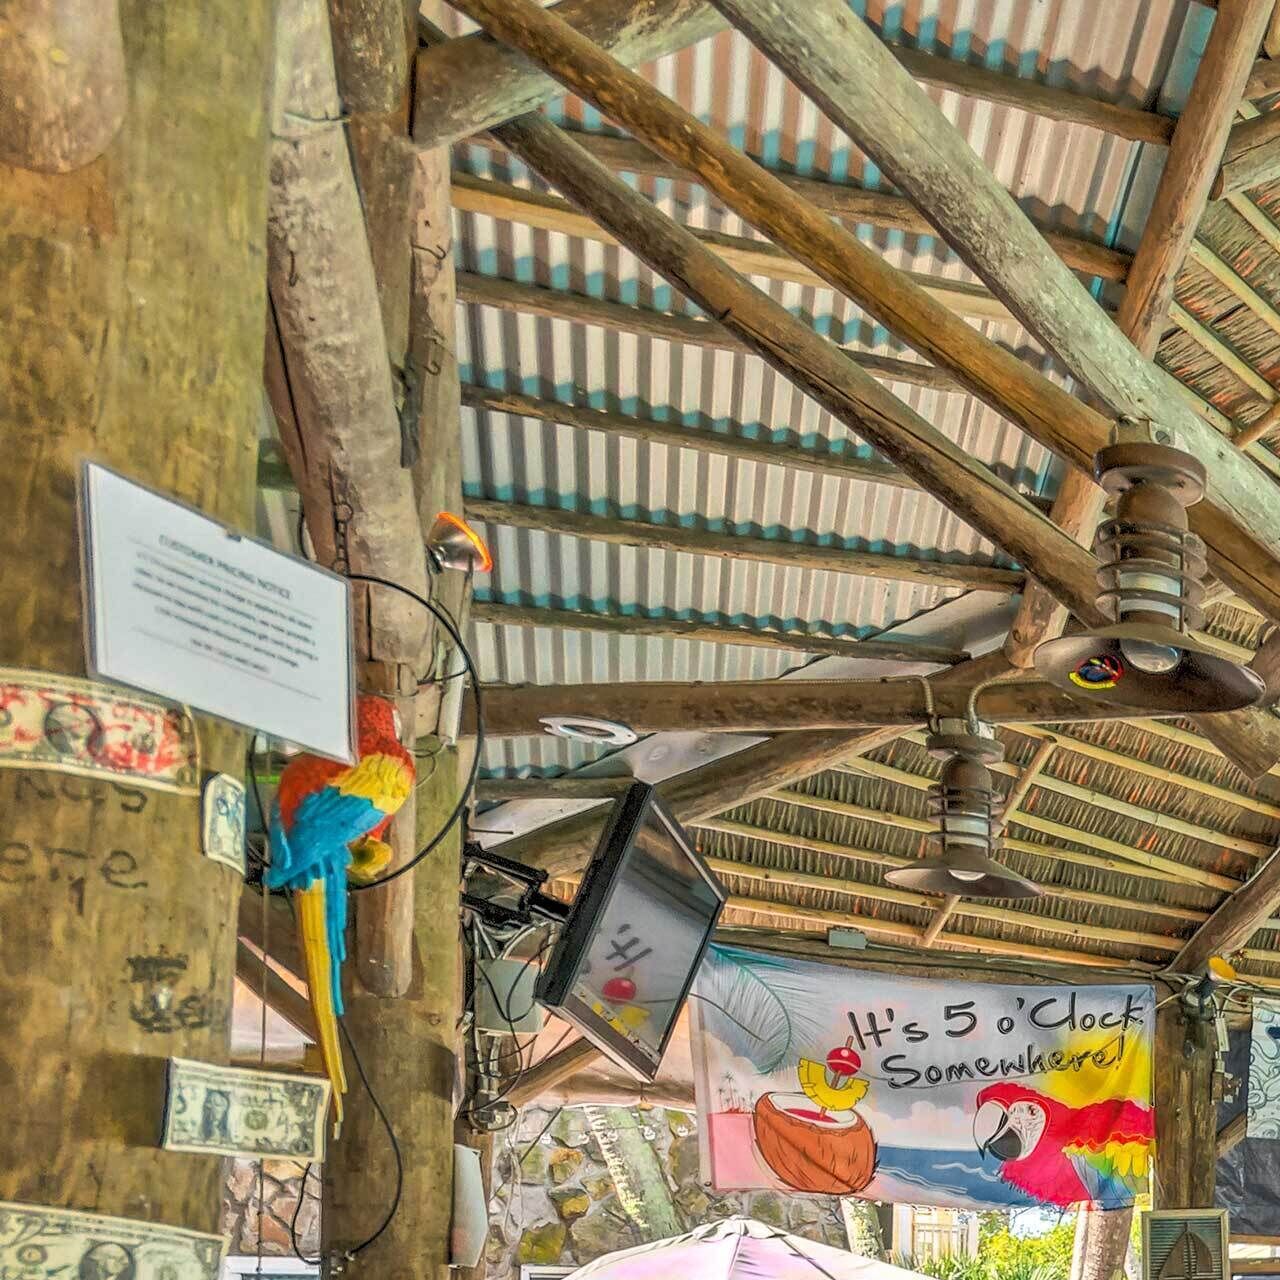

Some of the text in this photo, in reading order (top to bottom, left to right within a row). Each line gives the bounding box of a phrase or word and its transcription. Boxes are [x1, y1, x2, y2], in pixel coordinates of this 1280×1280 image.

[848, 991, 1144, 1050] It's 5 o'Clock
[880, 1032, 1126, 1090] Somewhere!
